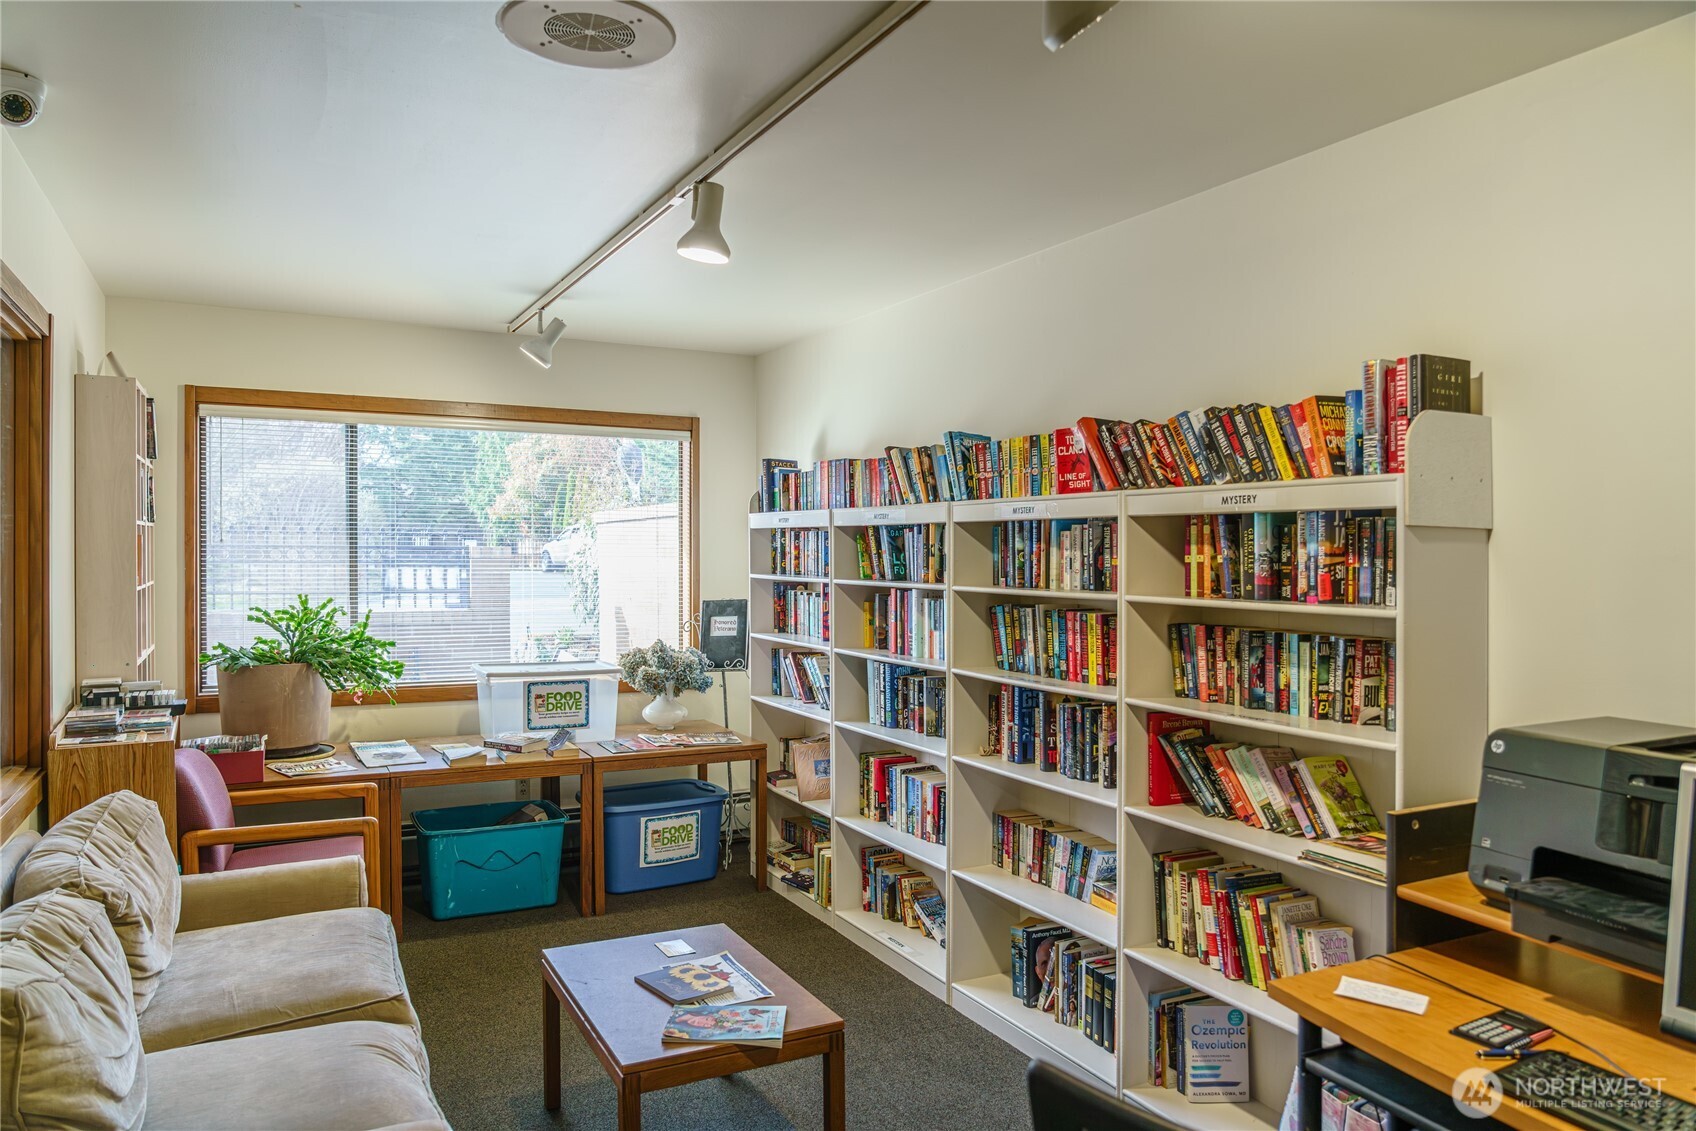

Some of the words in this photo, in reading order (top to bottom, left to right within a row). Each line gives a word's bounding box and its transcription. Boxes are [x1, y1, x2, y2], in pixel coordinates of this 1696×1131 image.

[1397, 364, 1407, 400] MICHAEL
[1065, 436, 1074, 444] TO
[1234, 414, 1249, 435] MICHAEL
[1242, 435, 1257, 459] CONNELLY
[1153, 427, 1166, 446] HARLAN
[1161, 447, 1172, 463] COBEN
[1363, 433, 1379, 464] TRACE
[1172, 425, 1185, 447] HARLAN
[1181, 447, 1194, 464] COBEN
[1188, 465, 1199, 478] WIN
[1069, 480, 1090, 488] SIGHT
[1221, 494, 1257, 505] MYSTERY
[1013, 506, 1035, 514] MYSTERY
[1260, 551, 1268, 577] ILES
[546, 691, 582, 702] FOOD
[547, 701, 582, 712] DRIVE
[1162, 720, 1181, 728] Brené
[662, 824, 693, 836] FOOD
[662, 833, 693, 846] DRIVE
[1281, 905, 1301, 913] JANETTE
[1032, 930, 1050, 939] Anthony
[1319, 934, 1347, 951] Sandra
[1322, 951, 1349, 966] Brown
[1191, 1024, 1245, 1038] Ozempic
[1192, 1040, 1246, 1050] Revolution
